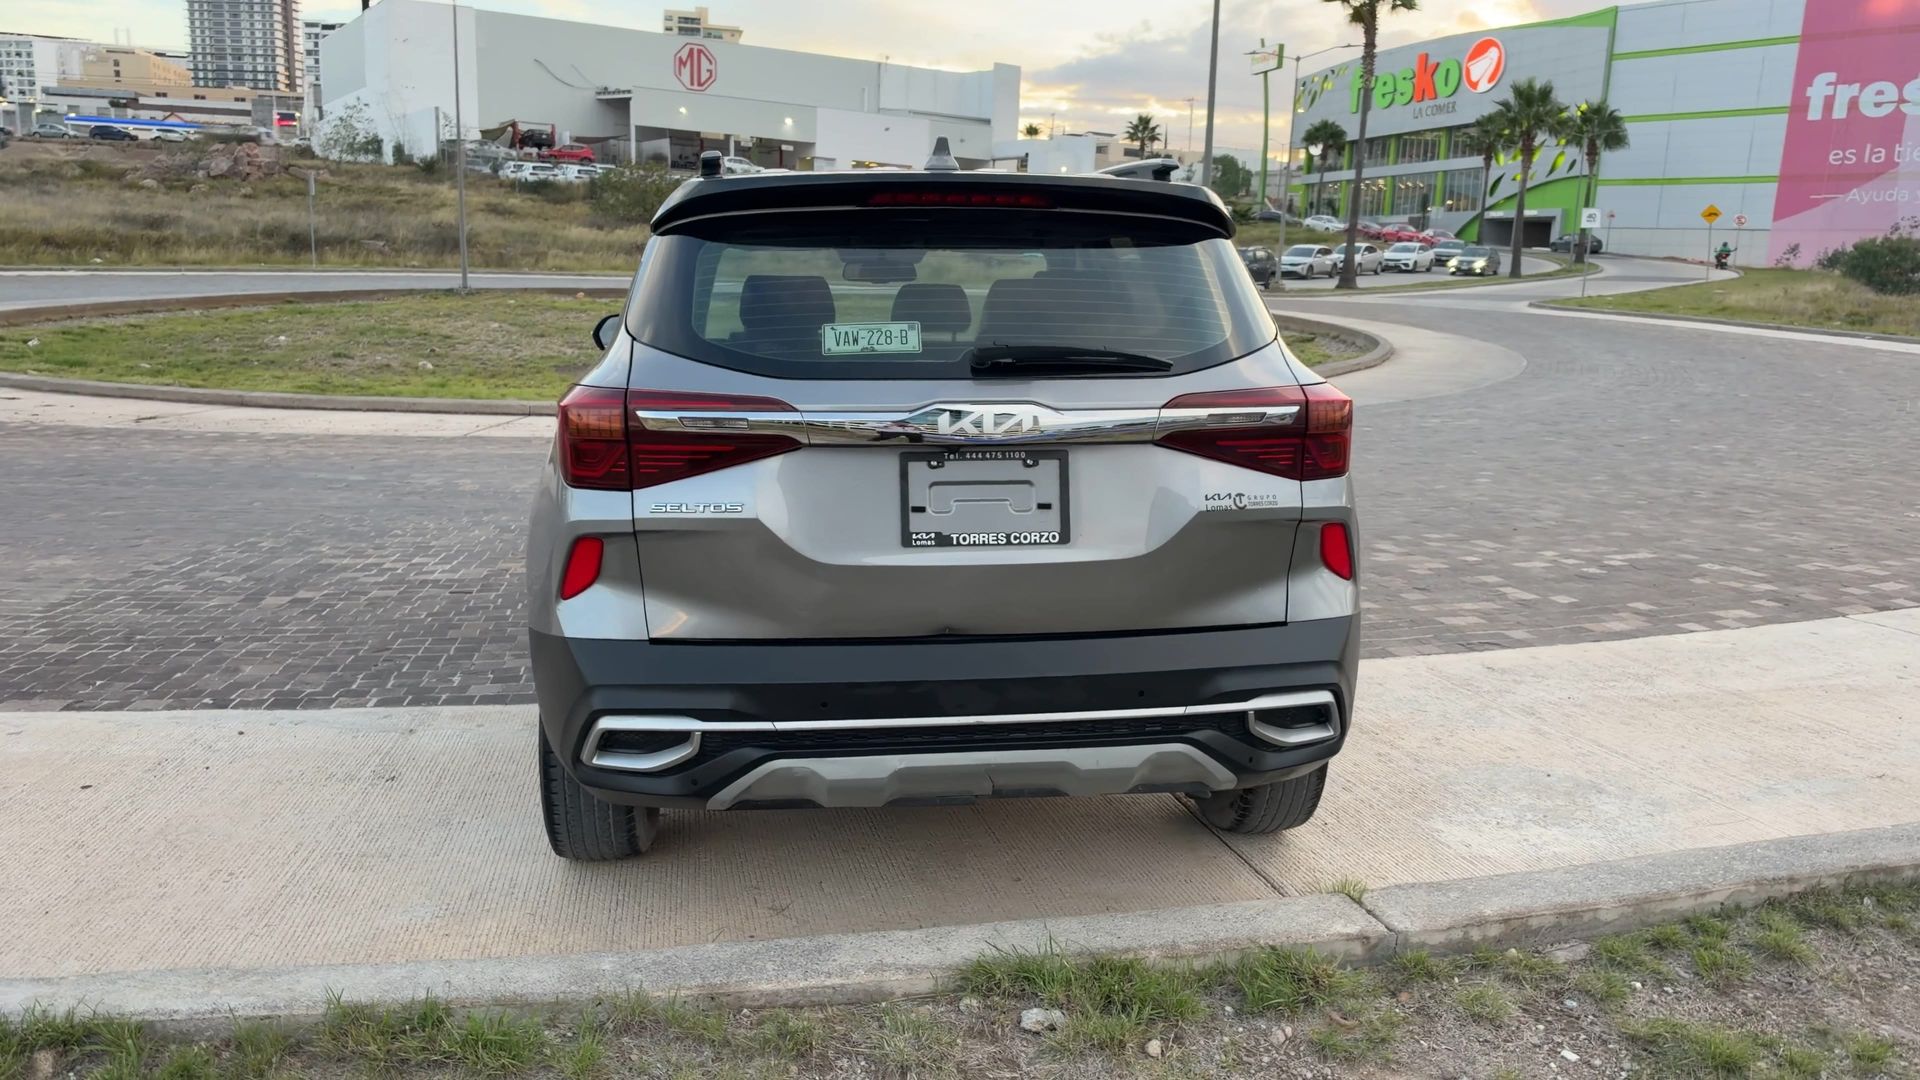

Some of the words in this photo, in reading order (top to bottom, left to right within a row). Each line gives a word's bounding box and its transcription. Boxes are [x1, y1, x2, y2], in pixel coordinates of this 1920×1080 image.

[678, 47, 713, 87] MG
[1413, 107, 1423, 119] LA
[1425, 101, 1457, 117] COMER
[1829, 149, 1857, 165] es
[1864, 143, 1886, 164] la
[1846, 187, 1909, 205] Ayuda
[834, 329, 909, 347] VAW-228-B
[937, 410, 1040, 434] KIA
[944, 452, 962, 460] Tel.
[965, 452, 982, 460] 444
[985, 451, 1002, 459] 475
[1005, 451, 1026, 459] 1100
[1205, 492, 1232, 502] KIA
[649, 503, 744, 513] SELTOS
[1206, 504, 1233, 512] Lomas
[950, 533, 1007, 545] TORRES
[1010, 532, 1060, 543] CORZO
